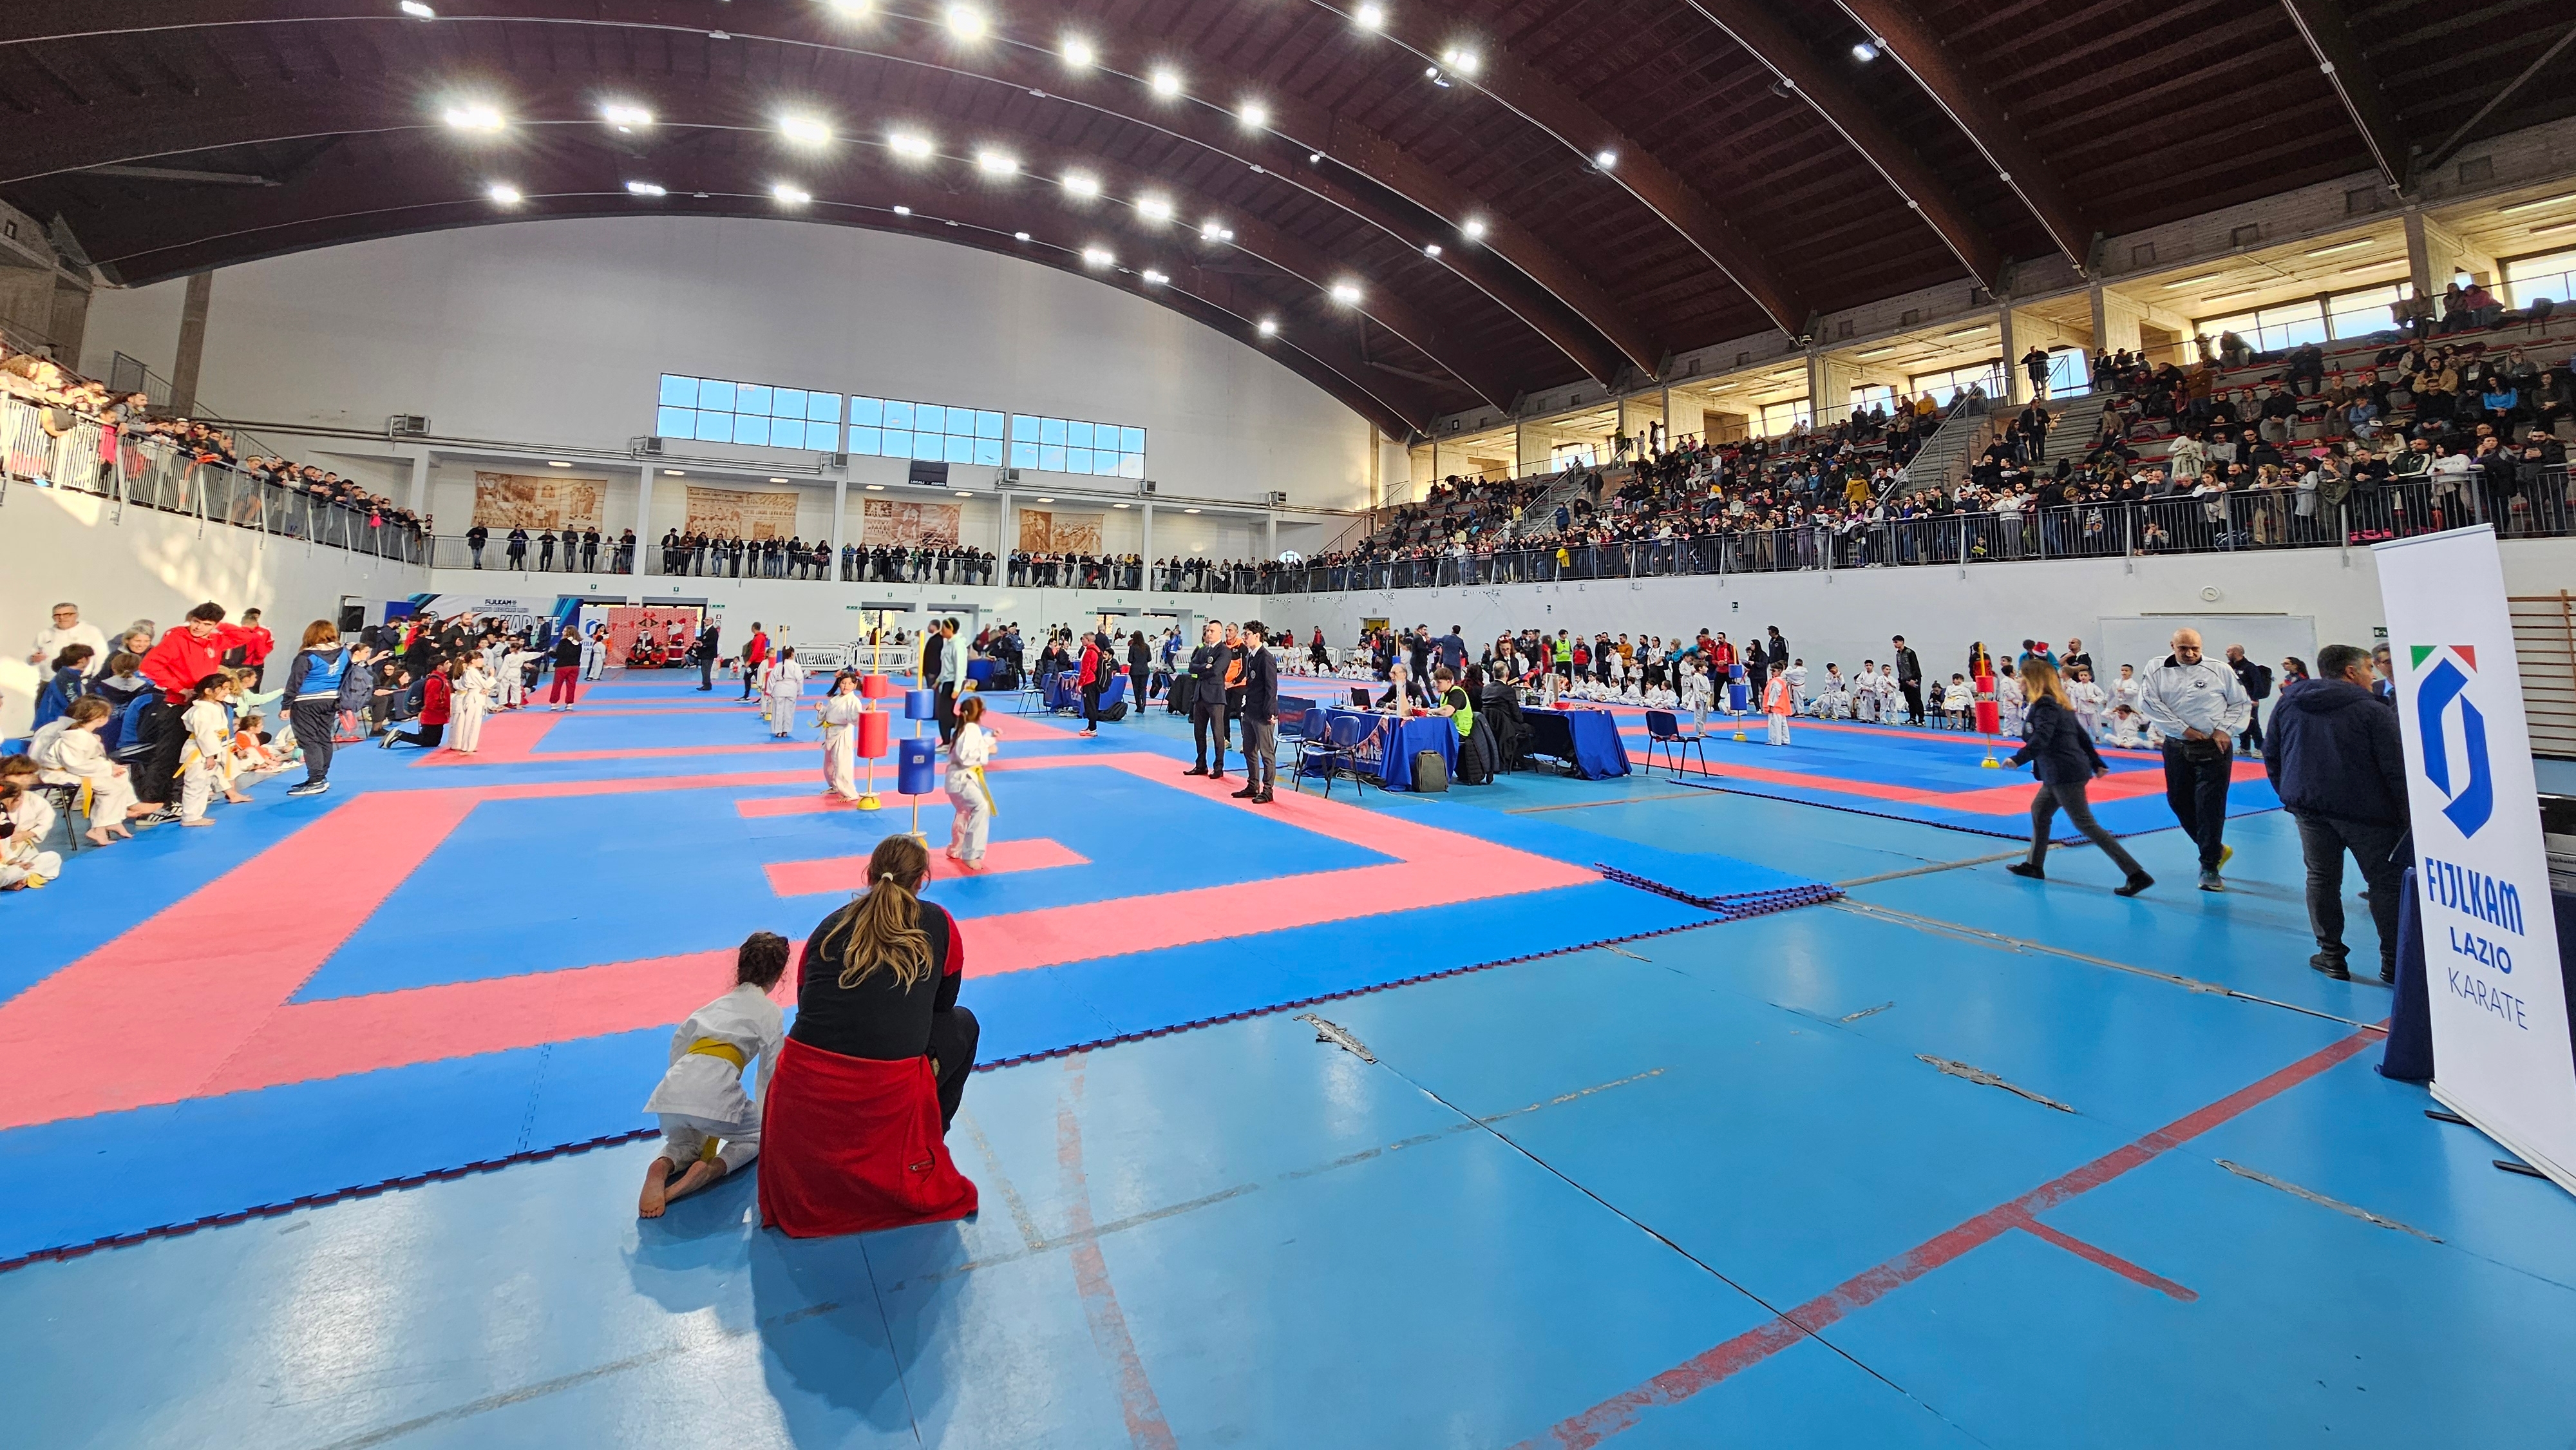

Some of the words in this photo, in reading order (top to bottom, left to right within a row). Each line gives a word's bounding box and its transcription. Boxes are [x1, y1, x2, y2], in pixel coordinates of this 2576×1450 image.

[2425, 856, 2525, 937] FIJLKAM
[2449, 926, 2512, 974] LAZIO
[2448, 967, 2528, 1031] KARATE
